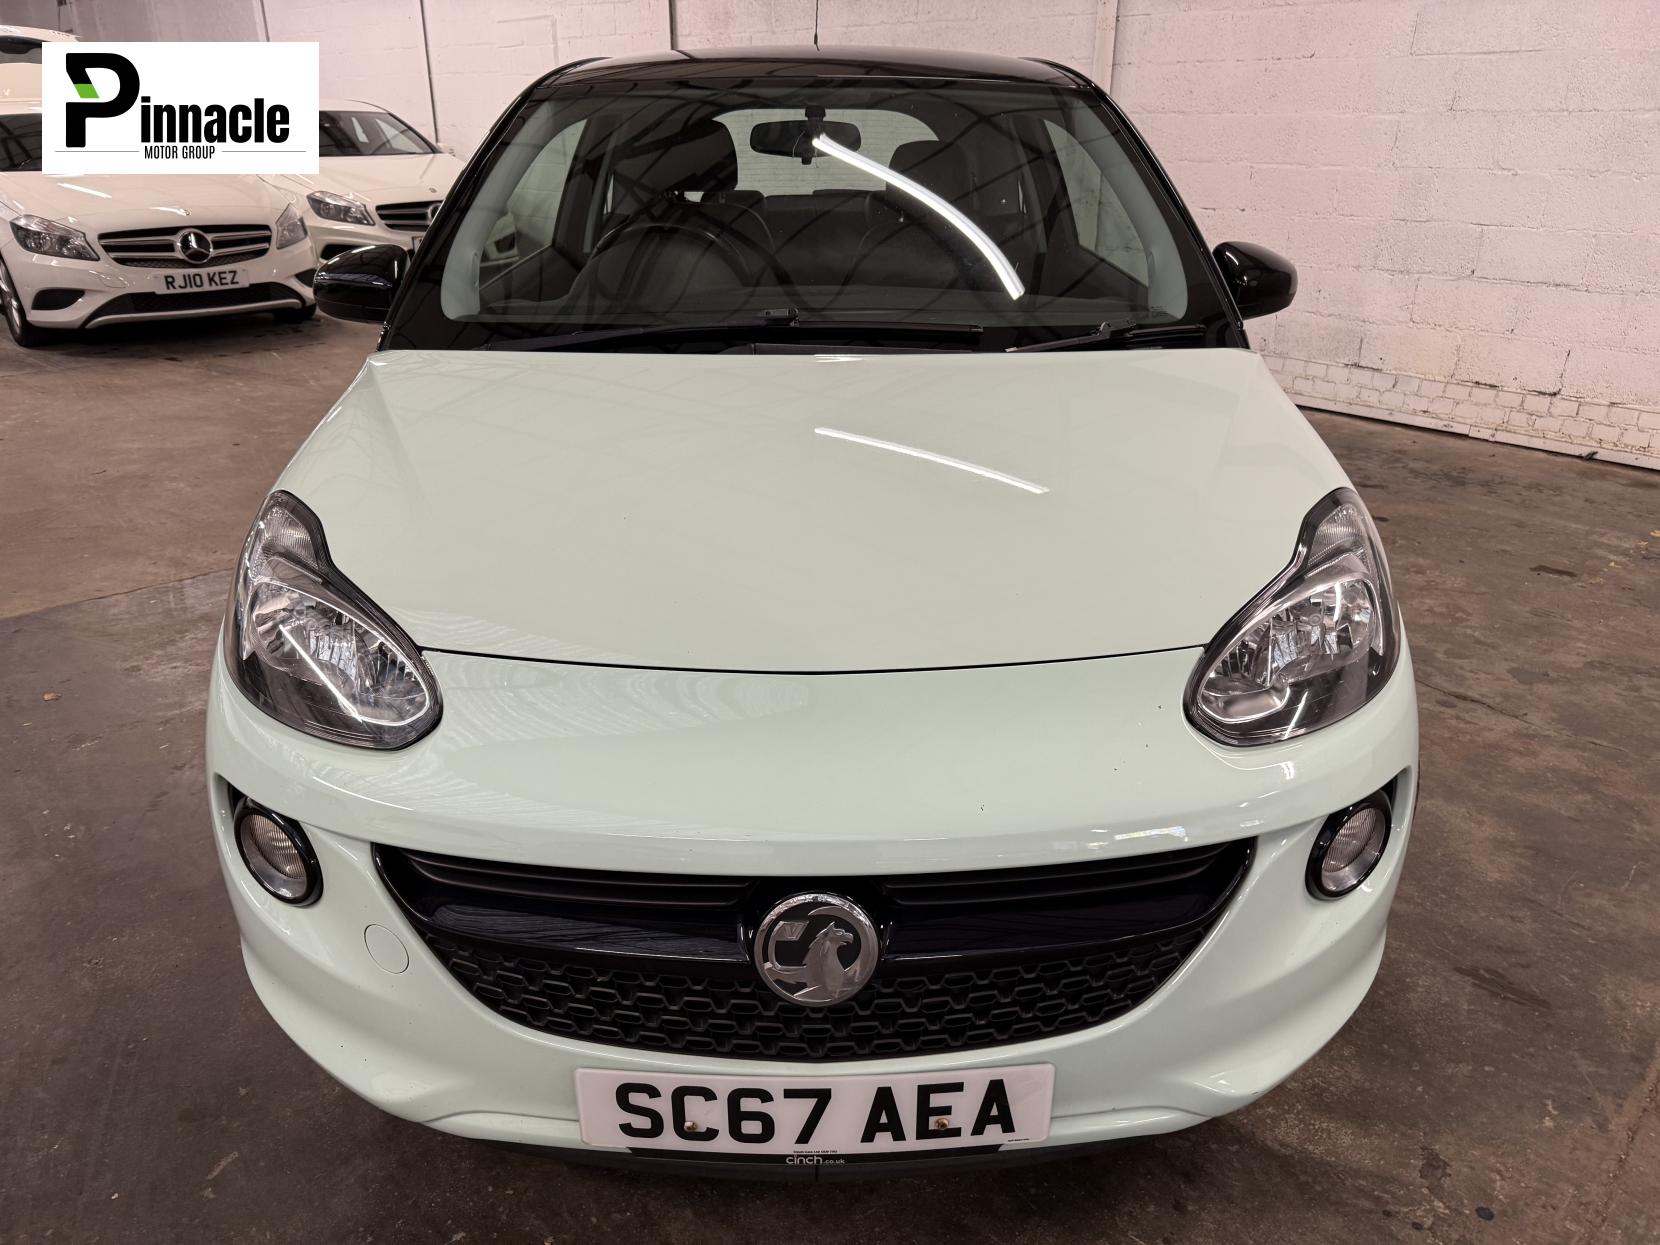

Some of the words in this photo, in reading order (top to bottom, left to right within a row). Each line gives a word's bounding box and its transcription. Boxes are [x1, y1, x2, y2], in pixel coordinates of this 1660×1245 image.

[164, 273, 204, 290] RJ10
[207, 270, 239, 287] KEZ
[615, 1082, 832, 1144] SC67
[860, 1079, 1016, 1144] AEA
